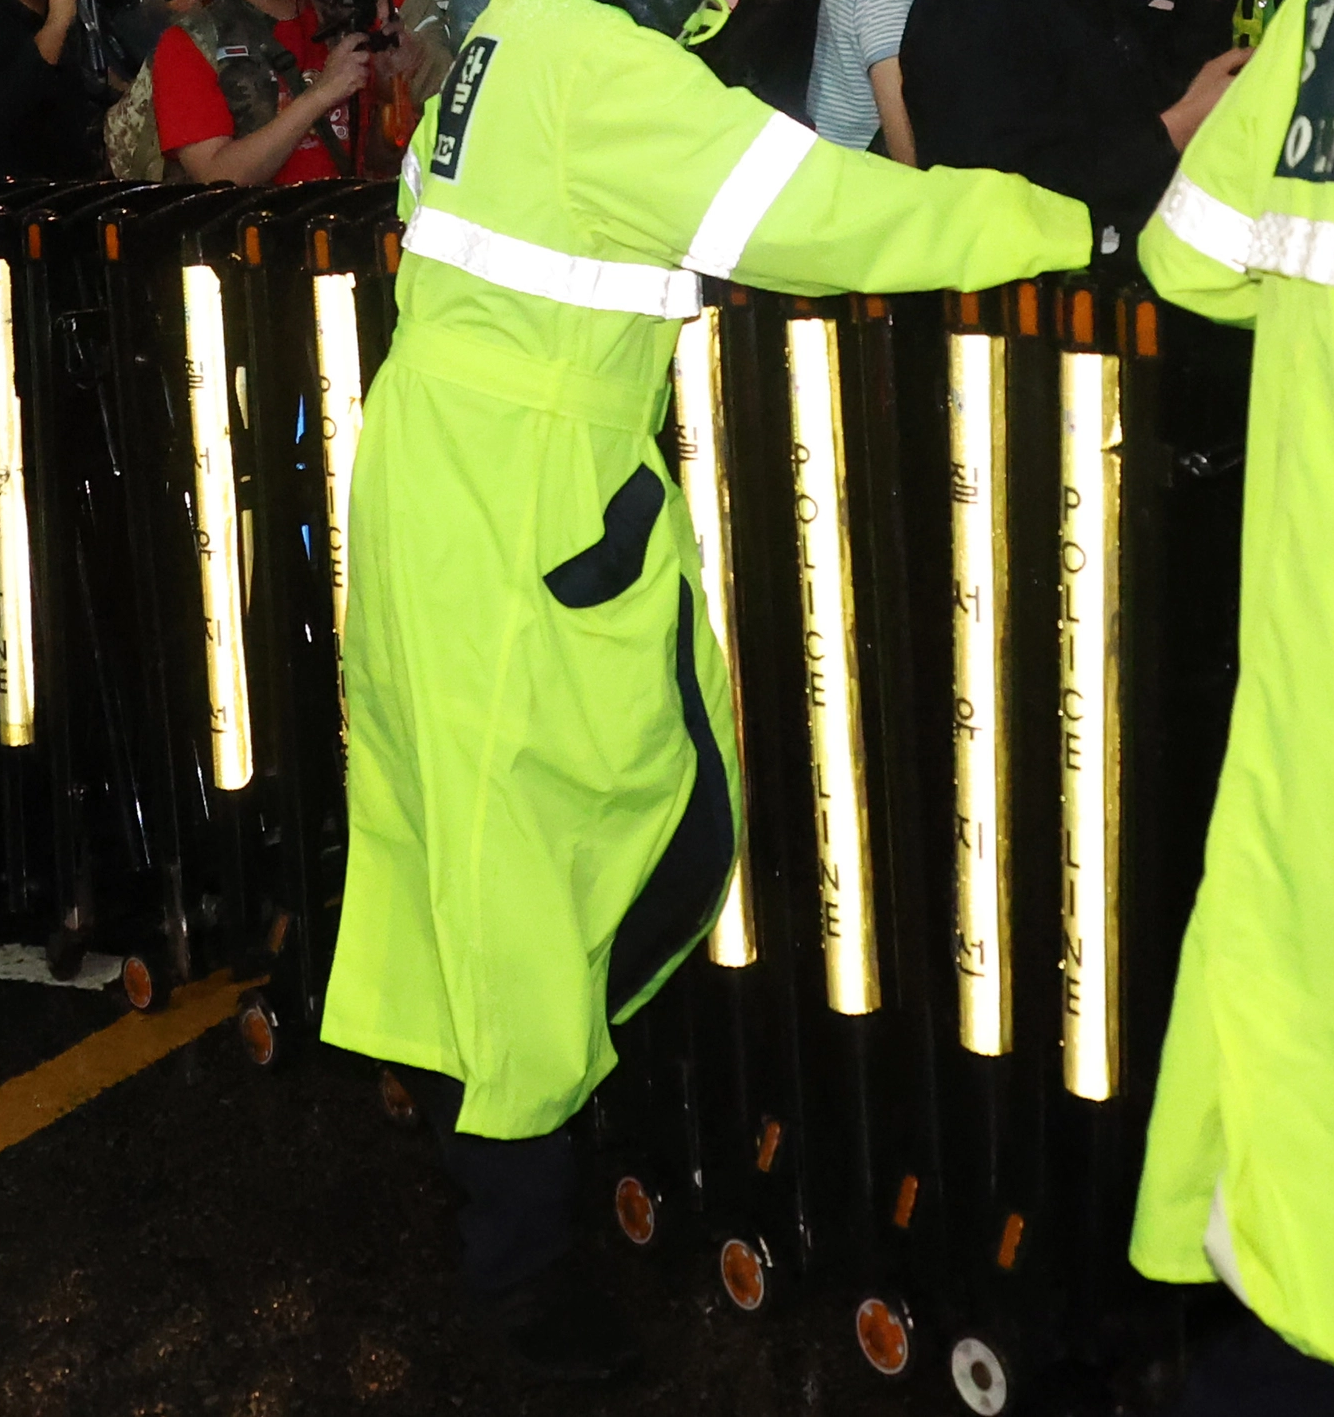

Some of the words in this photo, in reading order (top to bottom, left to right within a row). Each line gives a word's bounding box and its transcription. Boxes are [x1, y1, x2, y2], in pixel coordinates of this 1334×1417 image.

[790, 443, 826, 710] POLICE
[814, 768, 843, 940] LINE
[1061, 486, 1088, 771] POLICE
[1063, 828, 1083, 1017] LINE
